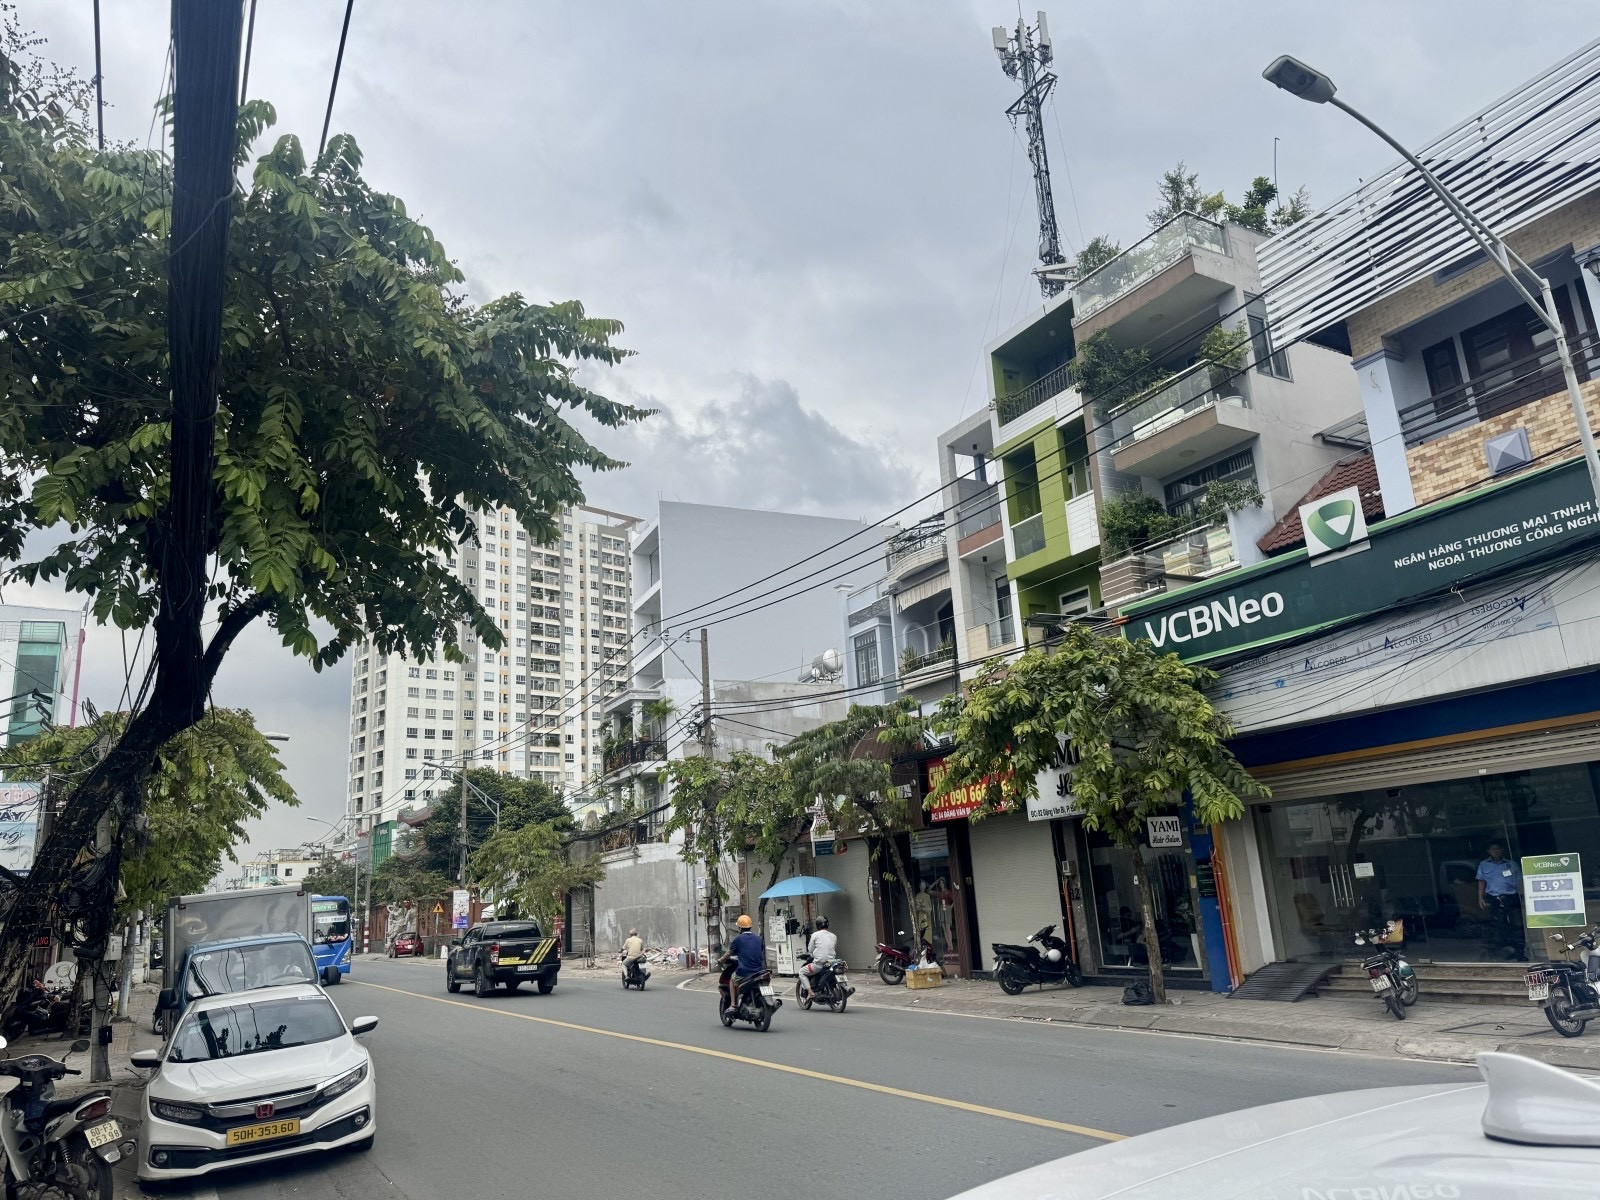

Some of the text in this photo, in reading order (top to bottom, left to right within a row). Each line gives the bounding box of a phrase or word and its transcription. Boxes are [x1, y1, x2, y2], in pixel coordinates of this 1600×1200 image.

[1393, 551, 1426, 569] NGÂN
[1428, 538, 1462, 558] HÀNG
[1464, 522, 1519, 548] THƯƠNG
[1522, 514, 1548, 529] MẠI
[1550, 501, 1591, 520] TNHH
[1428, 553, 1465, 571] NGOẠI
[1468, 536, 1522, 559] THƯƠNG
[1525, 522, 1563, 543] CÔNG
[1144, 591, 1285, 649] VCBNeo
[950, 787, 968, 806] 090
[1150, 820, 1179, 833] YAMI
[1533, 861, 1562, 869] VCBNeo
[90, 1122, 115, 1138] 60-F3
[91, 1129, 120, 1147] 653.98
[233, 1122, 294, 1141] 50H-353.60
